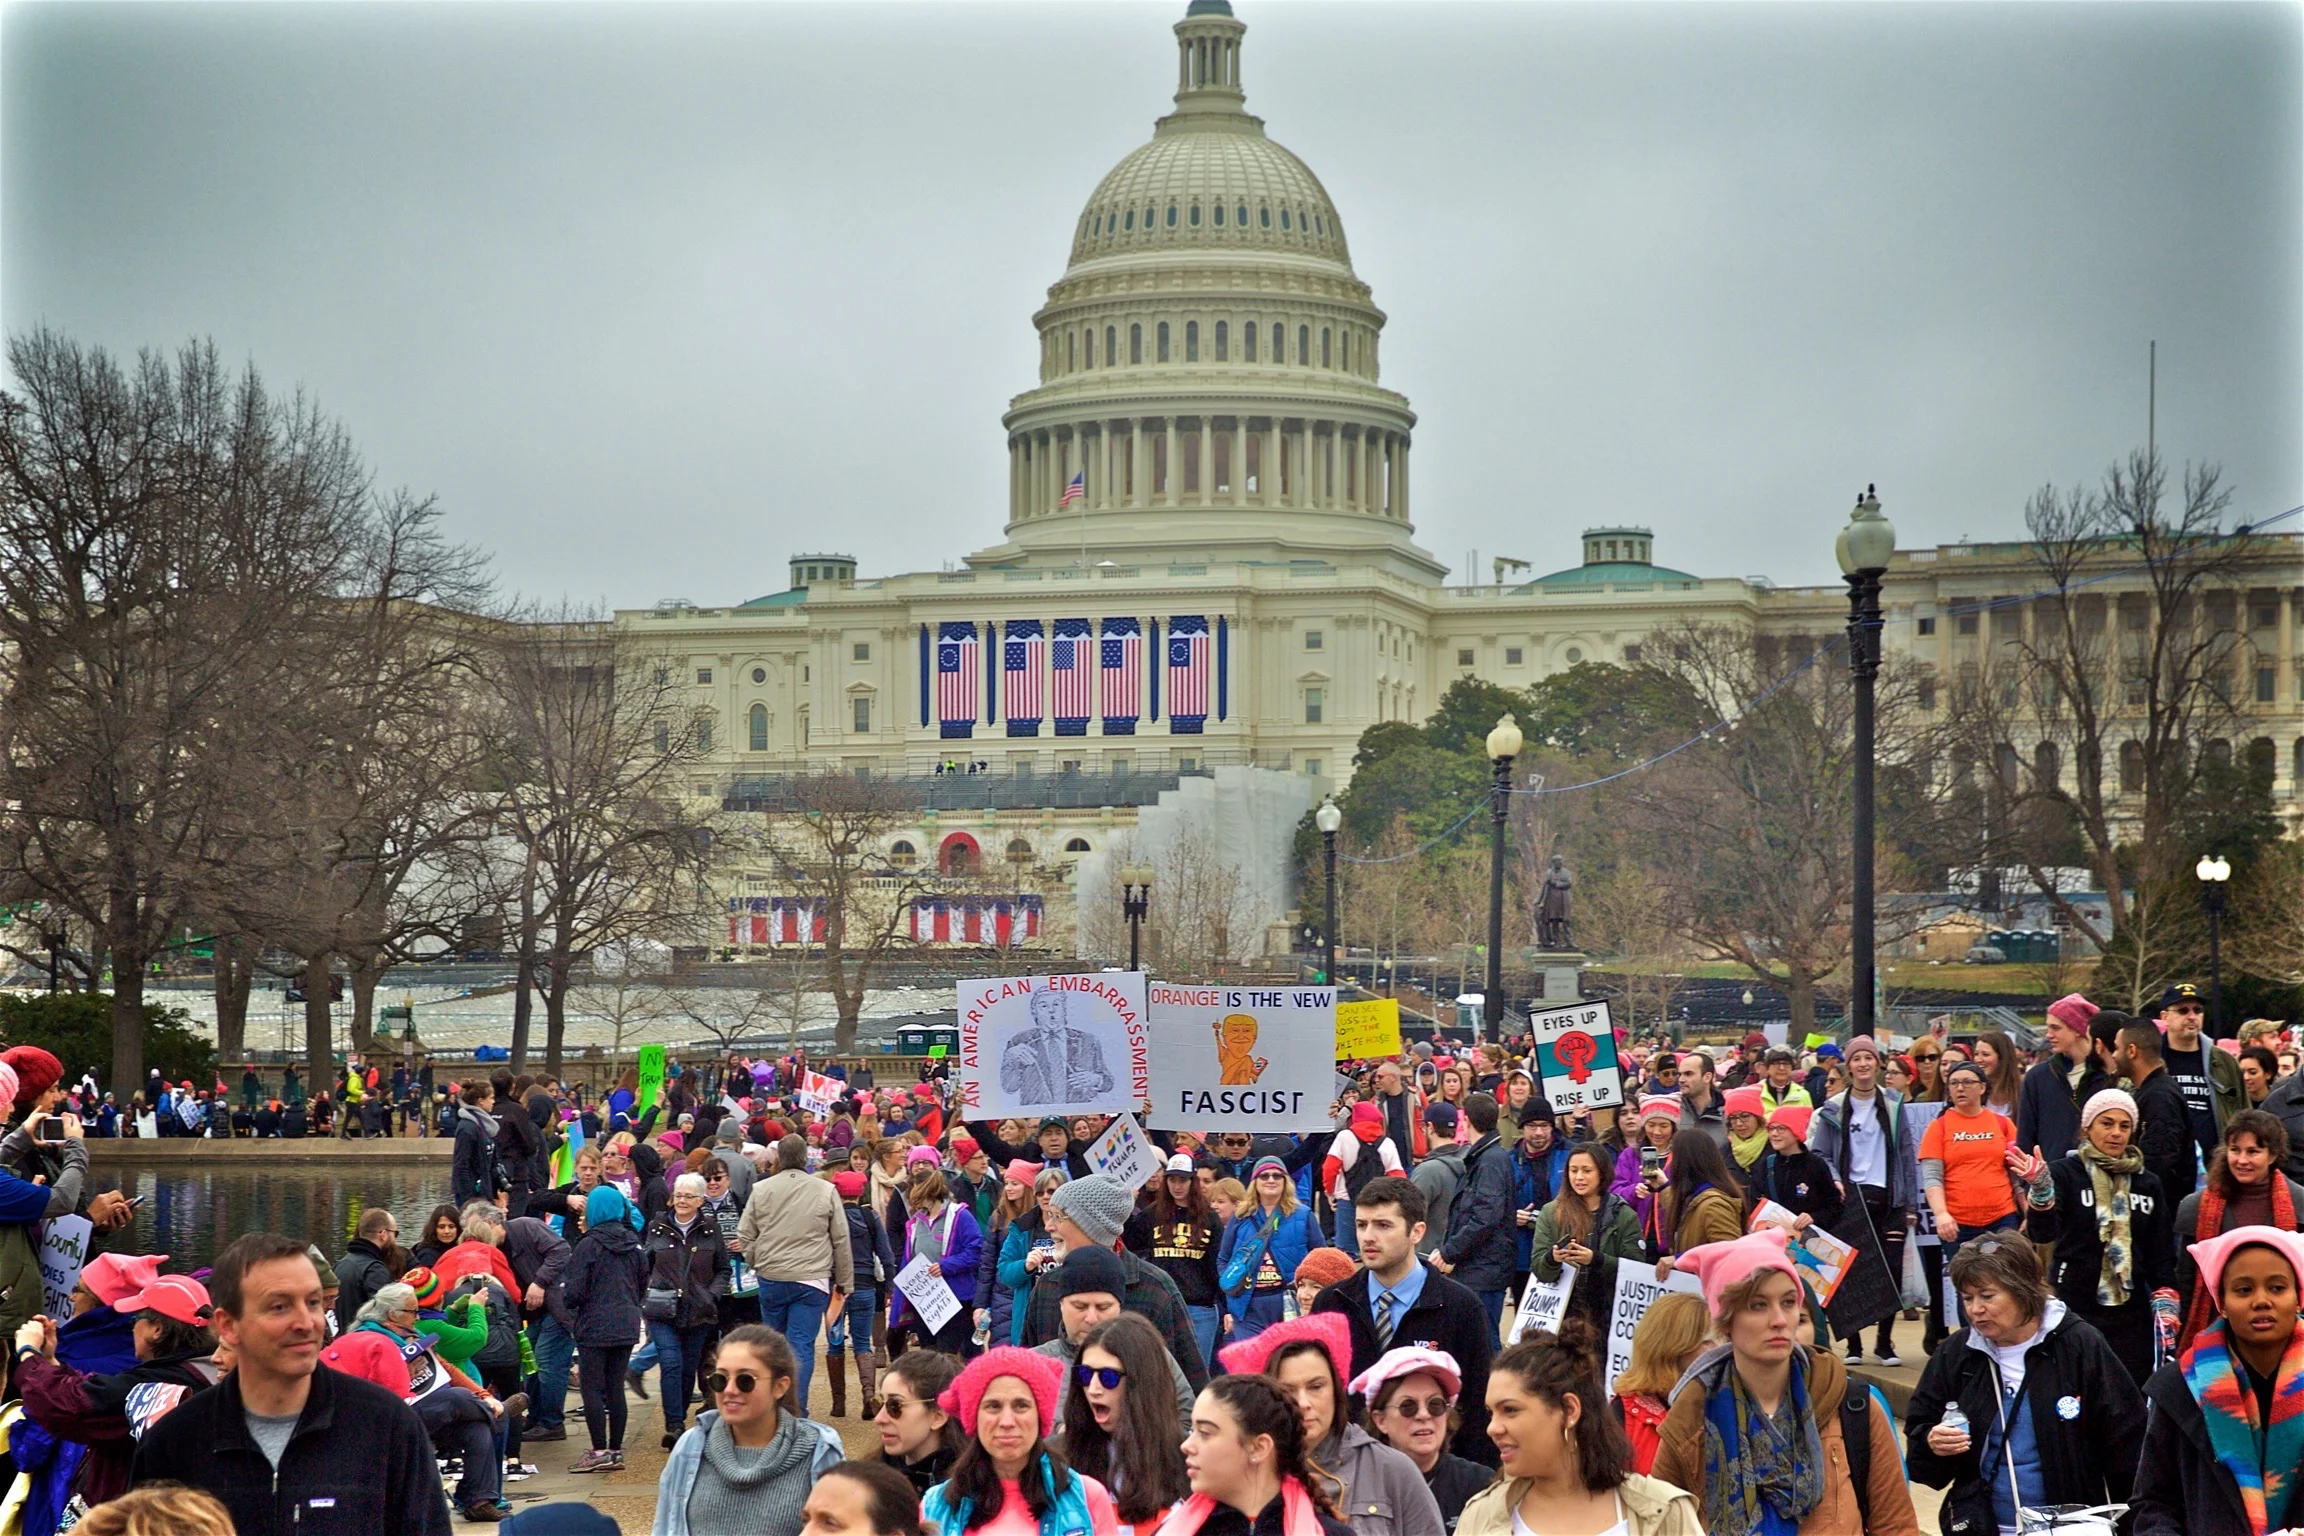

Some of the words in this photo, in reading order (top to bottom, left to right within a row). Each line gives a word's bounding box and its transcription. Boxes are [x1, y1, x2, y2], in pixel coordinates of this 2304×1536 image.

[1151, 988, 1219, 1007] ORANGE
[1226, 992, 1241, 1008] IS
[1248, 992, 1282, 1007] THE
[1293, 992, 1331, 1008] NEW
[963, 978, 1031, 1068] AMERICAN
[1543, 1015, 1574, 1031] EYES
[1581, 1011, 1597, 1024] UP
[1049, 976, 1148, 1098] EMBARRASSMENT
[963, 1081, 980, 1108] AN
[1181, 1090, 1303, 1114] FASCIST
[1555, 1092, 1584, 1107] RISE
[1593, 1087, 1609, 1101] UP
[43, 1218, 83, 1270] County
[43, 1285, 73, 1320] GHTS
[1621, 1280, 1677, 1302] JUSTIC
[1618, 1300, 1650, 1321] OVE
[1615, 1320, 1635, 1340] CO
